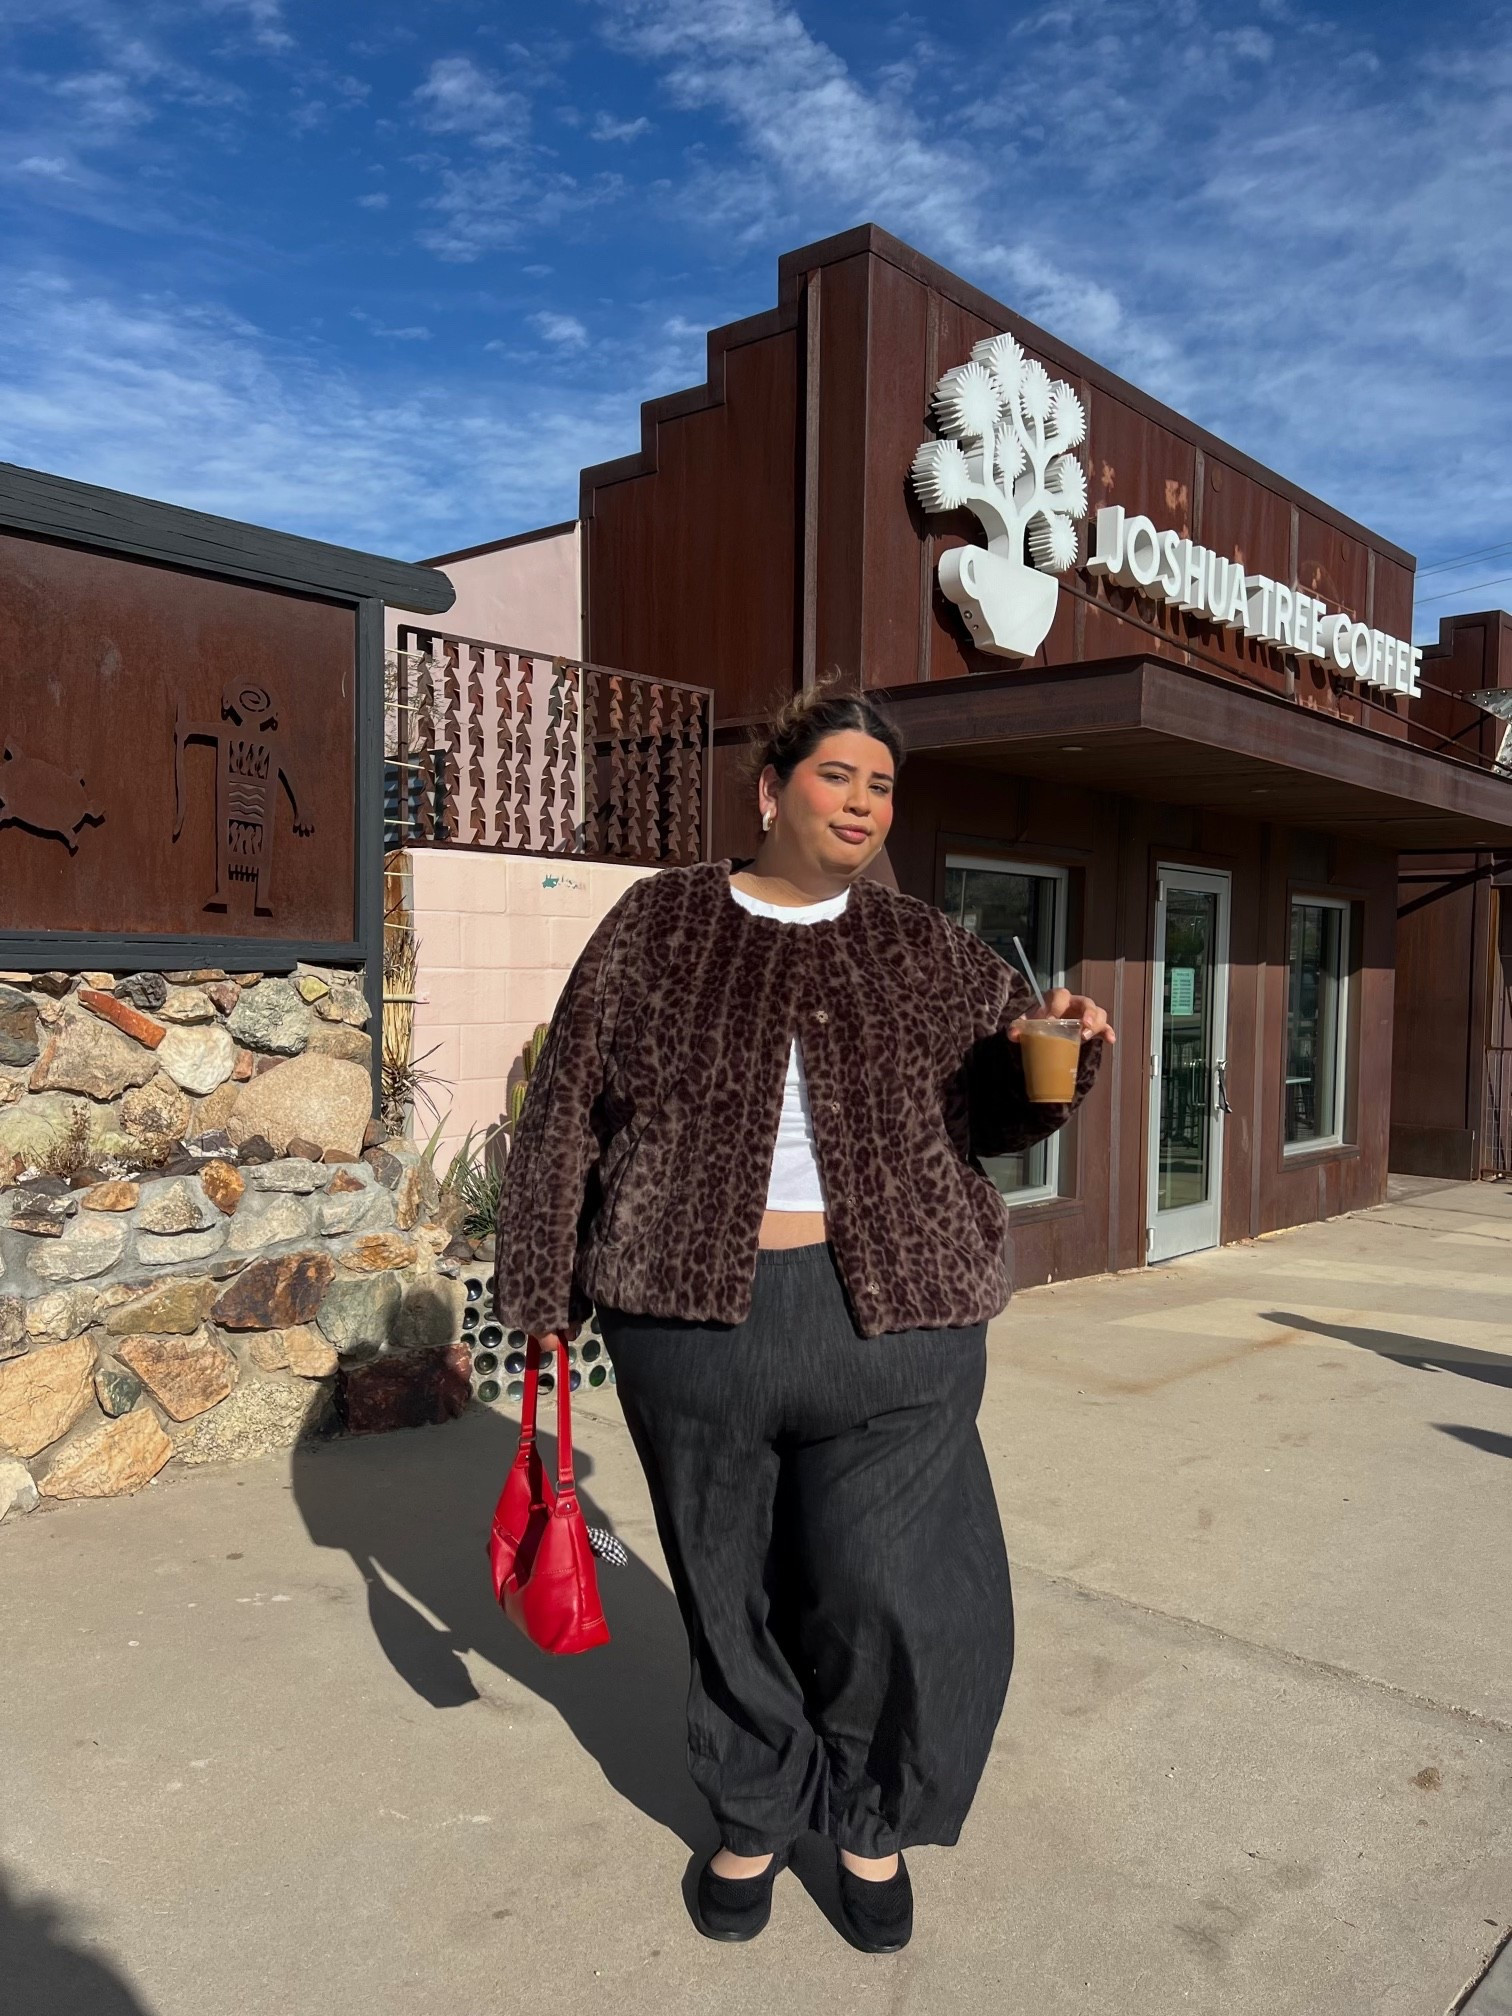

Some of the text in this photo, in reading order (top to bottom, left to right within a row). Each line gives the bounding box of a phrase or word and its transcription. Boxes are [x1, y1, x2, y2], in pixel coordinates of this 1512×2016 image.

[1087, 505, 1423, 698] JOSHUA TREE COFFEE
